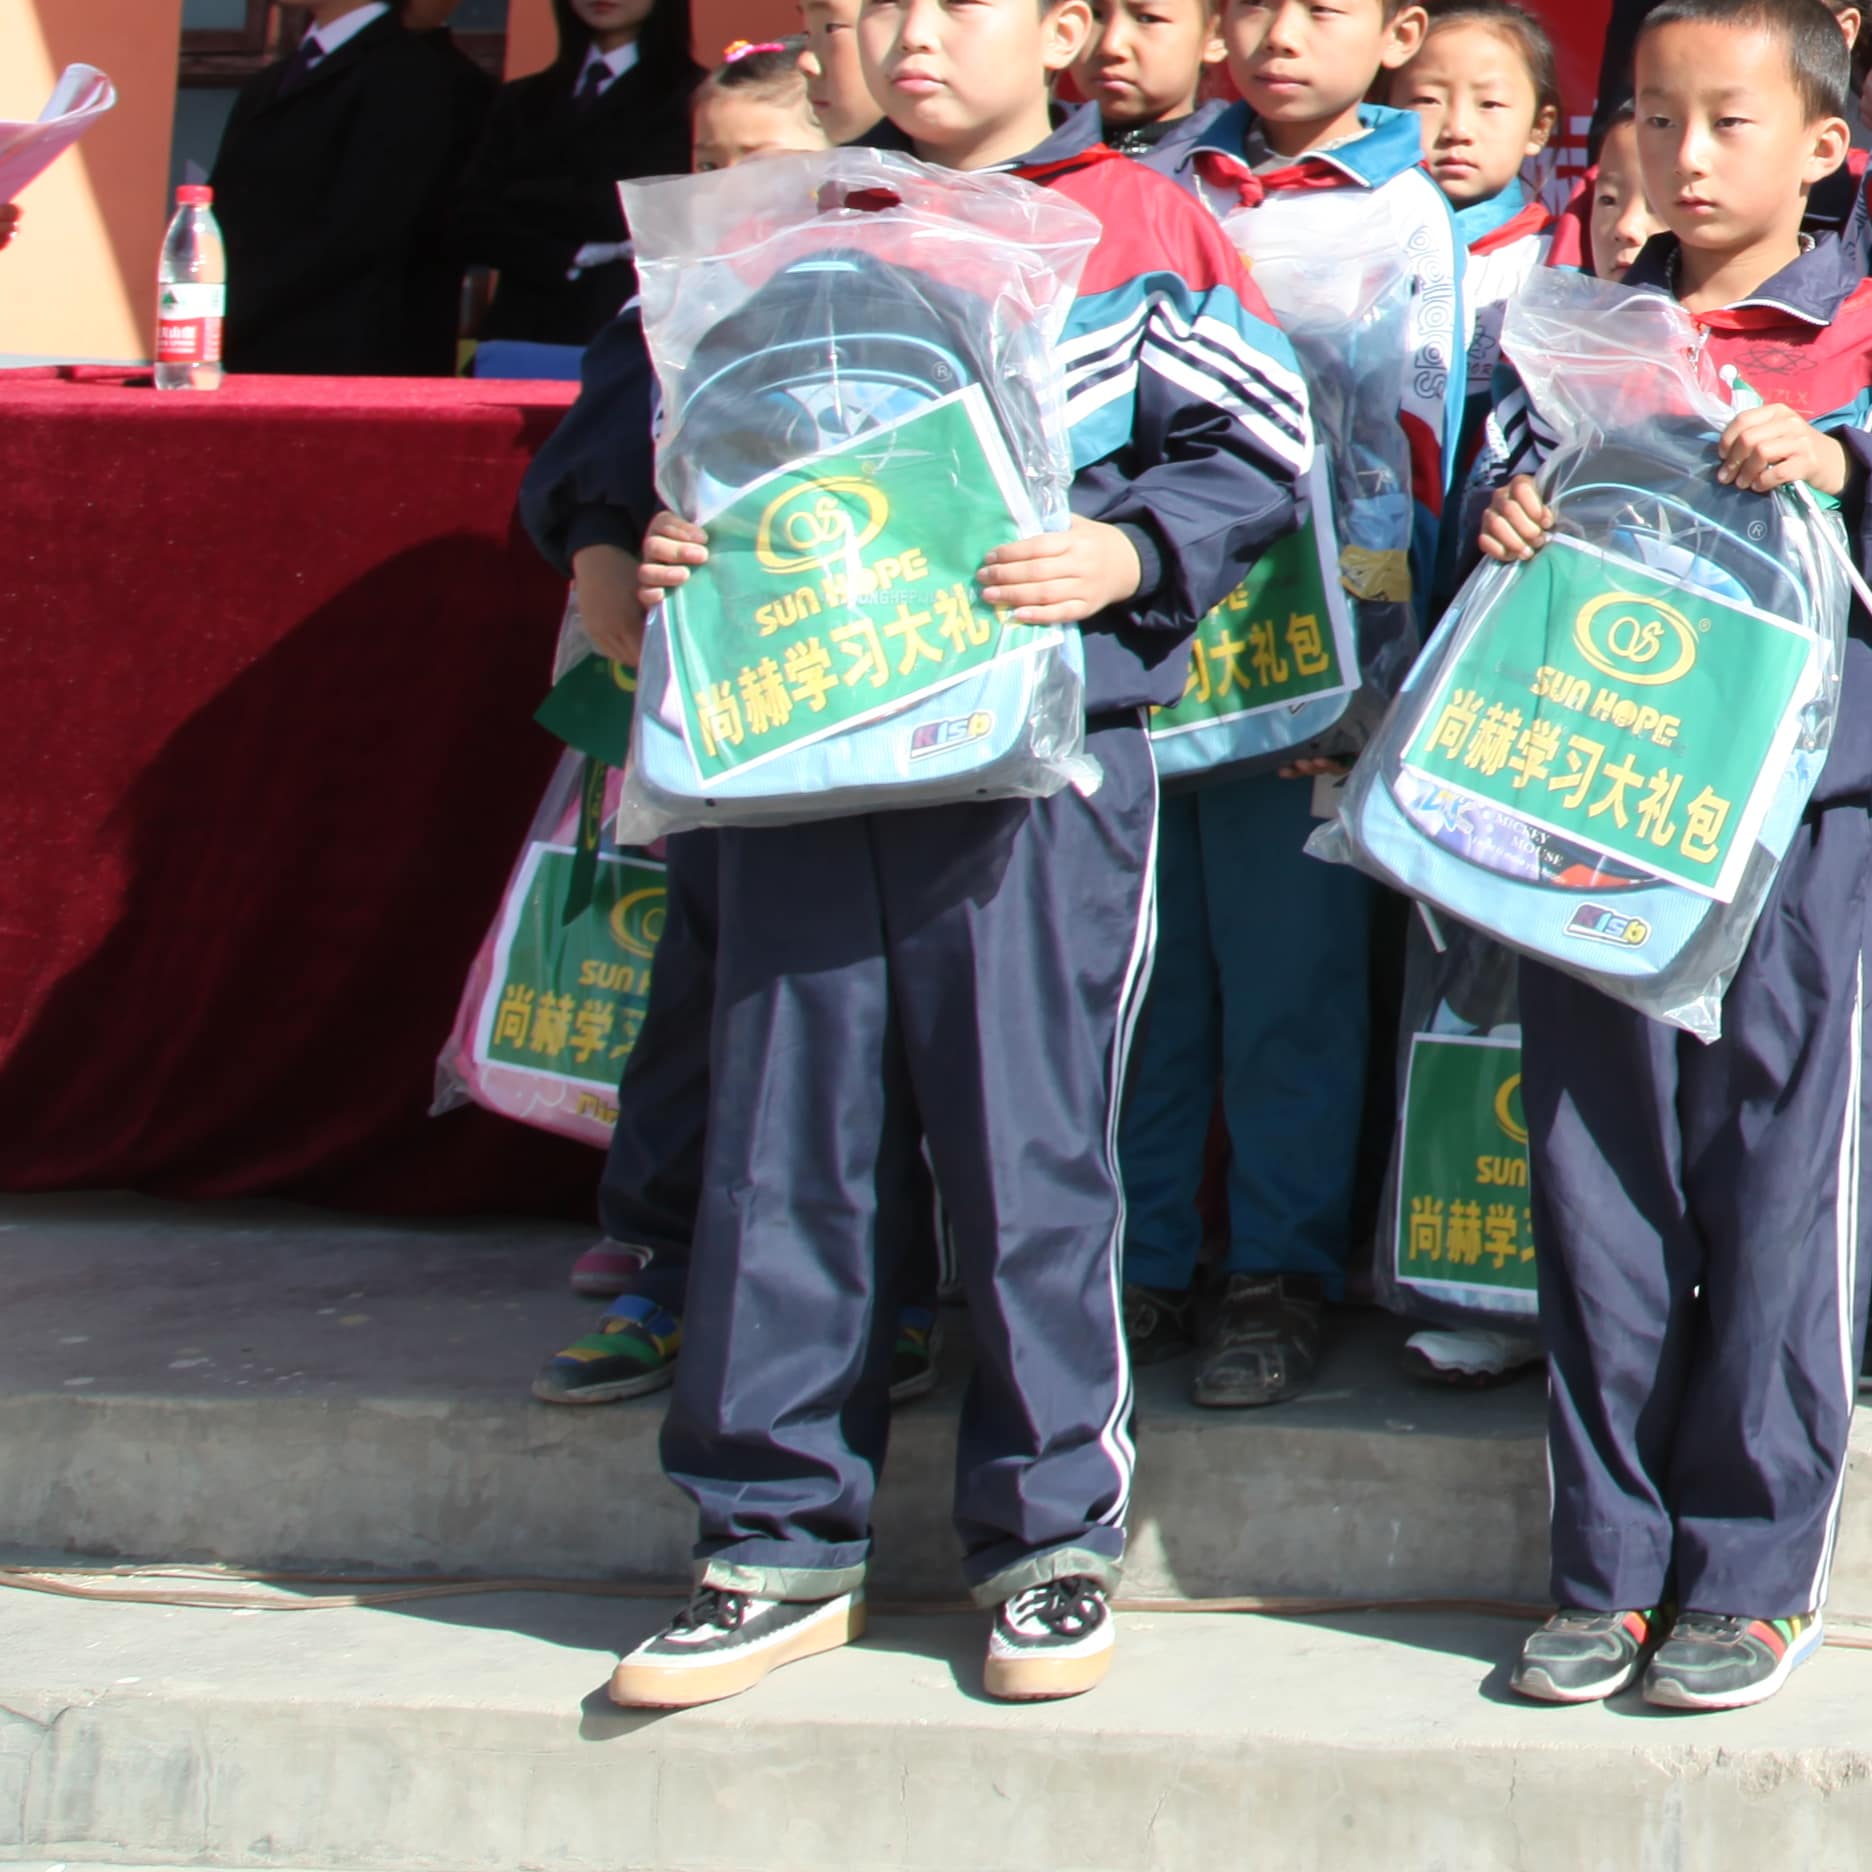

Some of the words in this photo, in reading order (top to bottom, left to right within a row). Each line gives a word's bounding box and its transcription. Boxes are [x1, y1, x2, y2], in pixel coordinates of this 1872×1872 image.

[755, 587, 823, 638] SUN
[696, 583, 1025, 757] 尚赫学习大礼
[1531, 665, 1594, 710] SUN
[1588, 688, 1682, 748] HOPE
[1424, 688, 1732, 864] 尚赫学习大礼包
[578, 960, 634, 991] SUN
[1408, 1194, 1537, 1270] 尚赫学
